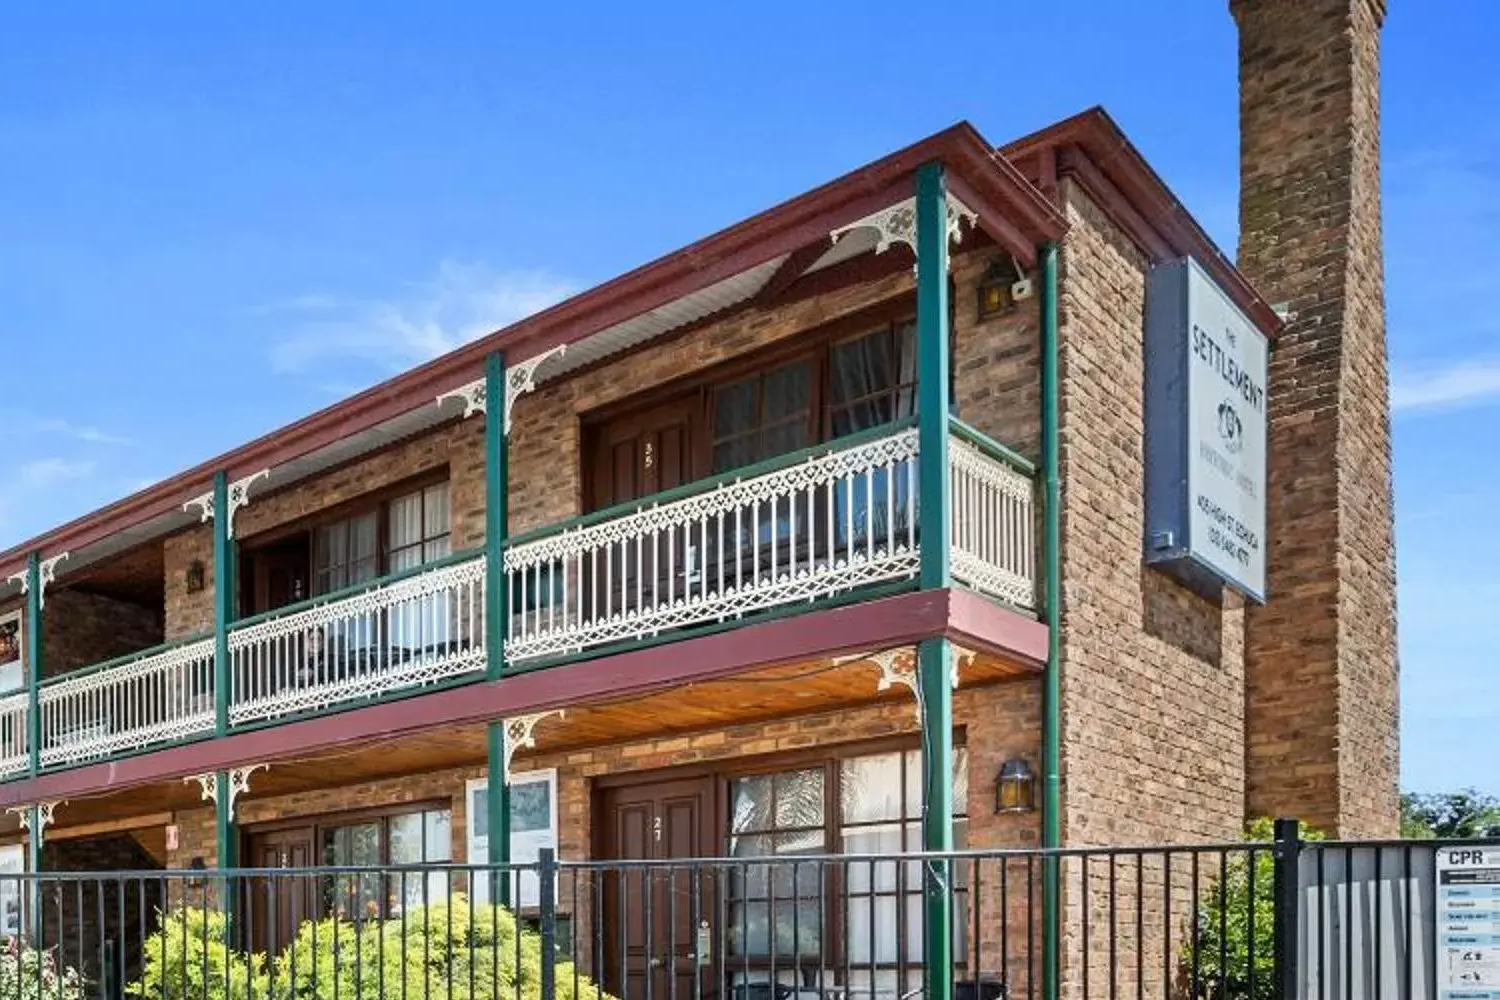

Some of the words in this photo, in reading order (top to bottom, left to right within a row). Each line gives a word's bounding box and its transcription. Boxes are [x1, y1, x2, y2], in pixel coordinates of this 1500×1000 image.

[1192, 324, 1263, 413] SETTLEMENT
[653, 817, 661, 841] 27
[1449, 850, 1483, 865] CPR
